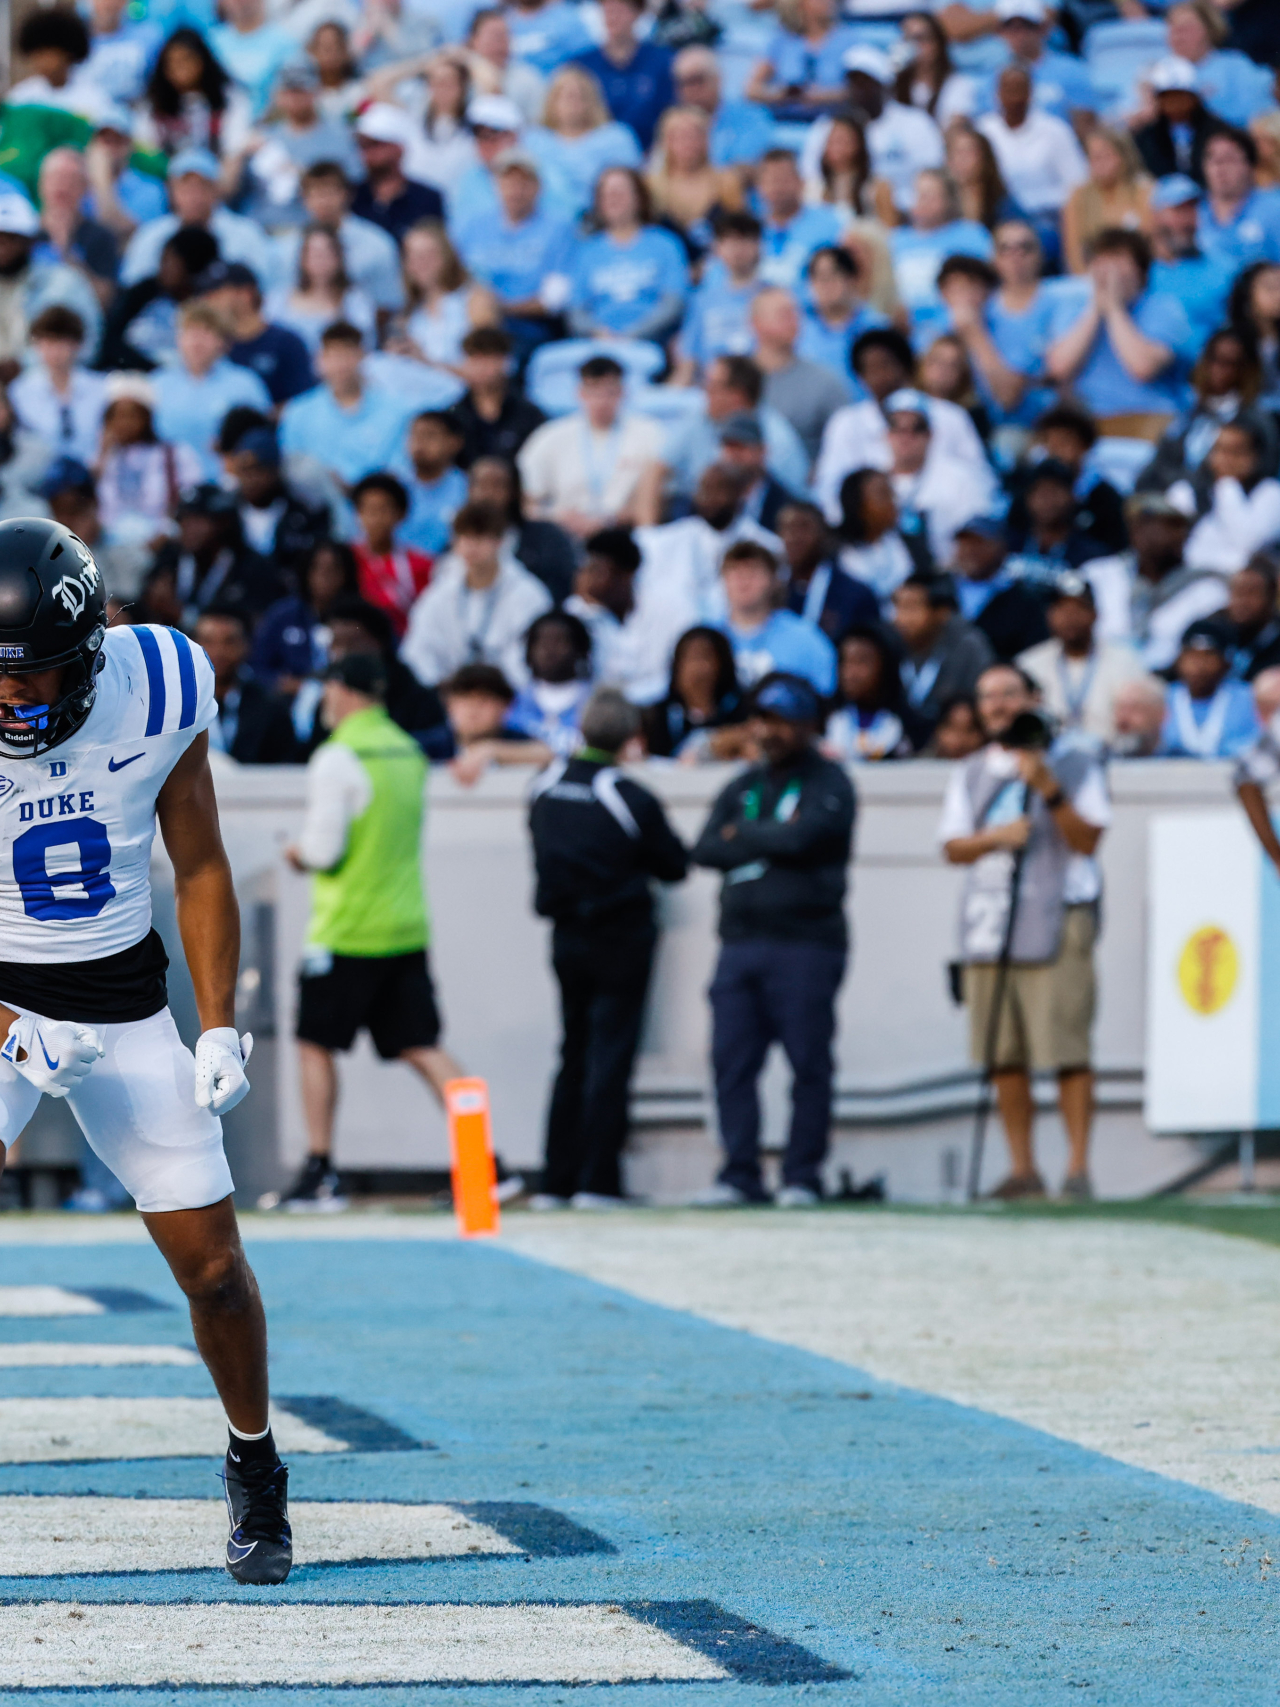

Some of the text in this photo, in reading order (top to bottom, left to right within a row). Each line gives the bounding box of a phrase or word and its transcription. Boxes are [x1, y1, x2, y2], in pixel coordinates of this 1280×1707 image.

[4, 732, 35, 741] Riddell
[49, 761, 67, 778] D
[19, 791, 95, 822] DUKE
[13, 817, 117, 921] 8
